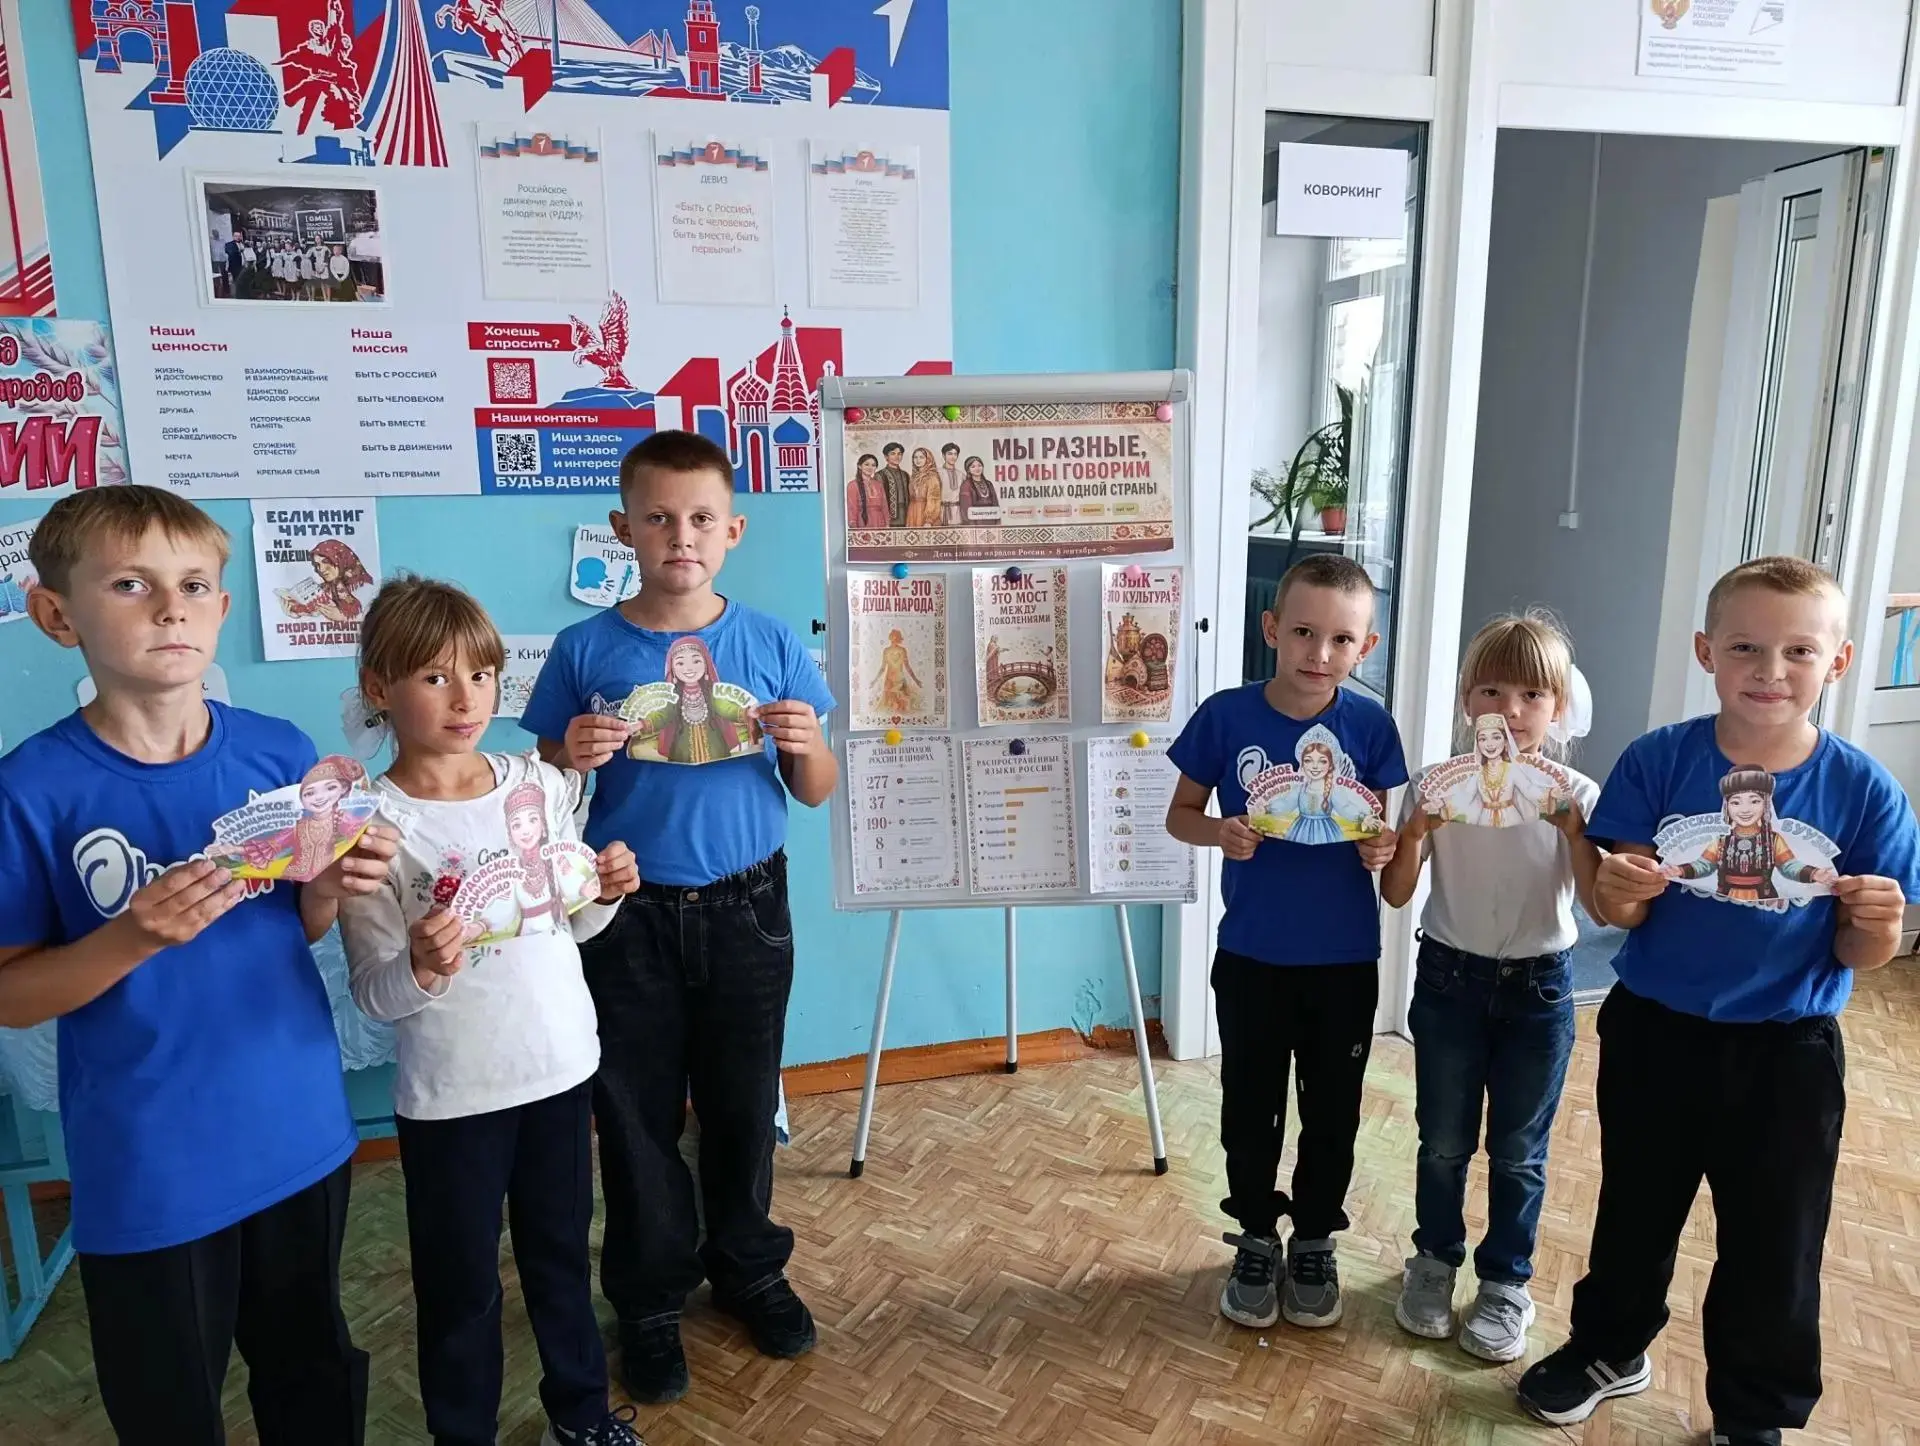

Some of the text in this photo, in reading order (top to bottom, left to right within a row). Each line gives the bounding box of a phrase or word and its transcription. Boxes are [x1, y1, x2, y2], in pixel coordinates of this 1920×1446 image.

[700, 175, 728, 184] ДЕВИЗ
[517, 184, 568, 194] Российское
[1304, 184, 1382, 198] КОВОРКИНГ
[503, 198, 547, 207] движение
[549, 199, 574, 208] детей
[672, 215, 696, 225] быть
[706, 218, 759, 230] человеком,
[673, 228, 696, 238] быть
[736, 232, 759, 242] быть
[150, 326, 196, 336] Наши
[351, 328, 392, 338] Наша
[484, 326, 540, 336] Хочешь
[151, 342, 228, 352] ценности
[352, 345, 408, 353] миссия
[485, 339, 560, 350] спросить?
[163, 374, 223, 382] ДОСТОИНСТВО
[392, 370, 437, 378] РОССИЕЙ
[246, 388, 288, 396] ЕДИНСТВО
[491, 412, 598, 424] Наши контакты
[552, 432, 622, 443] Ищи здесь
[398, 444, 453, 452] ДВИЖЕНИИ
[552, 447, 576, 455] все
[992, 434, 1147, 460] МЫ РАЗНЫЕ,
[564, 460, 621, 469] интерес
[168, 471, 240, 480] СОЗИДАТЕЛЬНЫЙ
[994, 460, 1150, 482] НО МЫ ГОВОРИМ
[1000, 482, 1158, 499] НА ЯЗЫКАХ ОДНОЙ СТРАНЫ
[266, 510, 364, 523] ЕСЛИ КНИГ
[278, 524, 356, 536] ЧИТАТЬ
[274, 539, 292, 548] НЕ
[602, 548, 636, 563] прав
[932, 550, 952, 558] День
[1018, 548, 1046, 556] России
[864, 580, 900, 596] ЯЗЫК
[911, 580, 931, 596] ЭТО
[992, 590, 1048, 605] ЭТО МОСТ
[1108, 590, 1171, 604] ЭТО КУЛЬТУРА
[862, 597, 934, 614] ДУША НАРОДА
[1000, 605, 1037, 616] МЕЖДУ
[990, 614, 1051, 626] ПОКОЛЕНИЯМИ
[276, 622, 316, 634] СКОРО
[985, 764, 1053, 775] ЯЗЫКИ РОССИИ
[1420, 755, 1476, 791] ОСЕТИНСКОЕ
[866, 775, 889, 790] 277
[1247, 764, 1292, 791] РУССКОЕ
[1248, 775, 1305, 806] ТРАДИЦИОННОЕ
[1336, 777, 1382, 814] ОКРОШКА
[869, 796, 886, 810] 37
[214, 801, 293, 831] ТАТАРСКОЕ
[218, 810, 302, 840] ТРАДИЦИОННОЕ
[1654, 814, 1721, 846] БУРЯТСКОЕ
[876, 836, 884, 850] 8
[878, 856, 883, 869] 1
[476, 881, 510, 910] БЛЮДО
